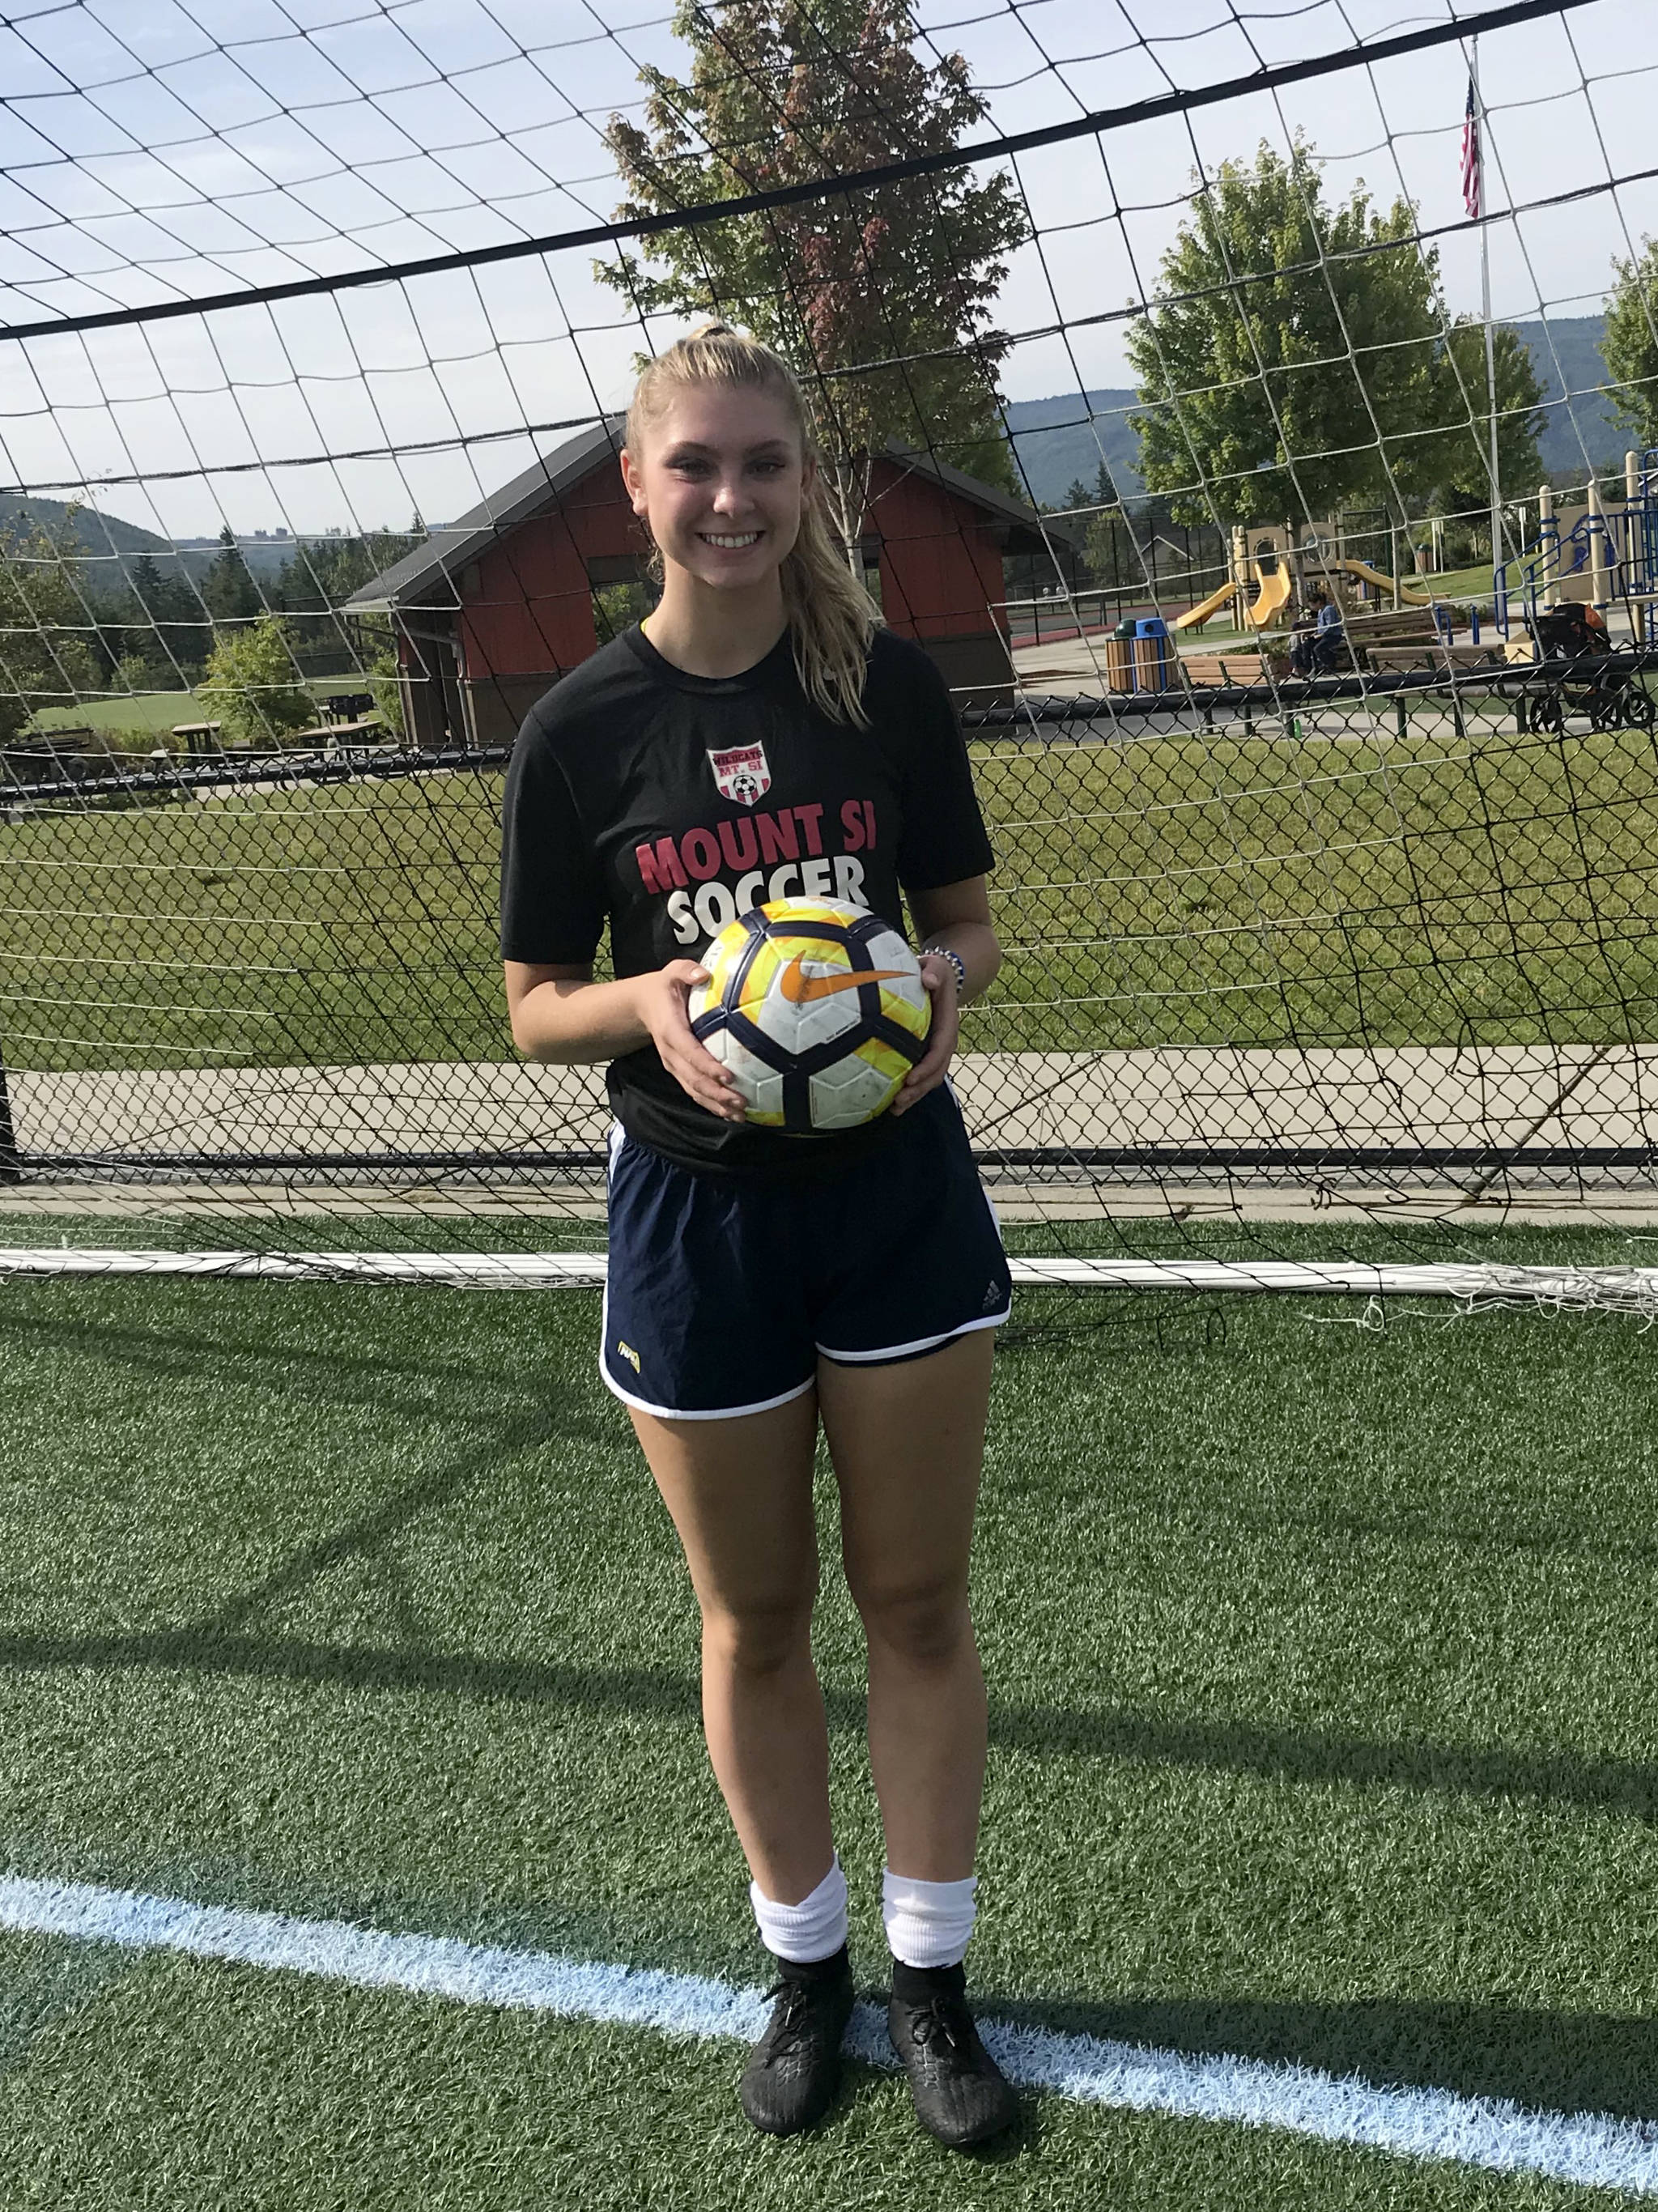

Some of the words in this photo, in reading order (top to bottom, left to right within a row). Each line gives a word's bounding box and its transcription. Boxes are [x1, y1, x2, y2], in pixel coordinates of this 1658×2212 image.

[712, 750, 763, 765] WILDCATS
[748, 760, 763, 771] SI
[636, 804, 823, 894] MOUNT
[840, 800, 877, 852] SI
[667, 855, 869, 944] SOCCER
